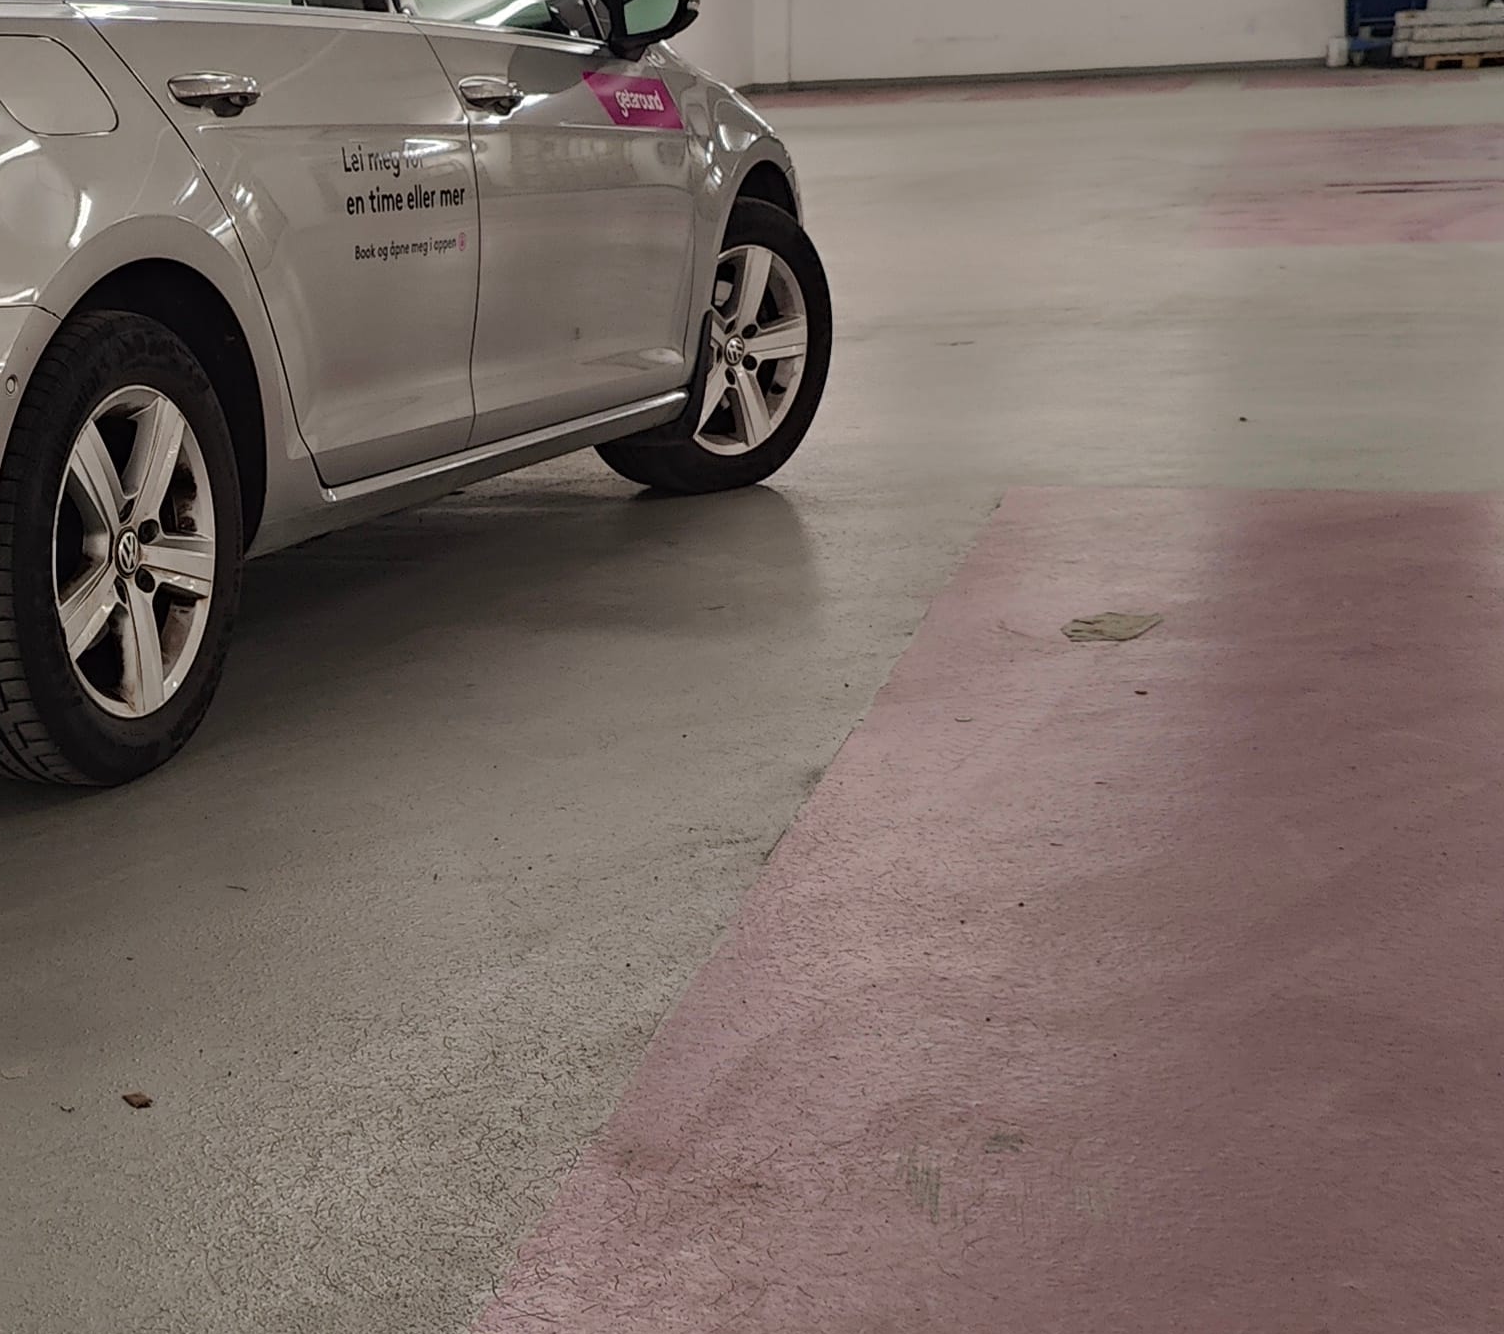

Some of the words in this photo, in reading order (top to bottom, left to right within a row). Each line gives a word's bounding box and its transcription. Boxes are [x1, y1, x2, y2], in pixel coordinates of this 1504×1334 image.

[615, 89, 665, 118] getaround
[346, 195, 365, 215] en
[368, 185, 403, 213] time
[407, 183, 436, 210] eller
[440, 187, 466, 208] mer
[354, 244, 377, 260] Book
[377, 245, 389, 261] og
[411, 240, 428, 257] meg
